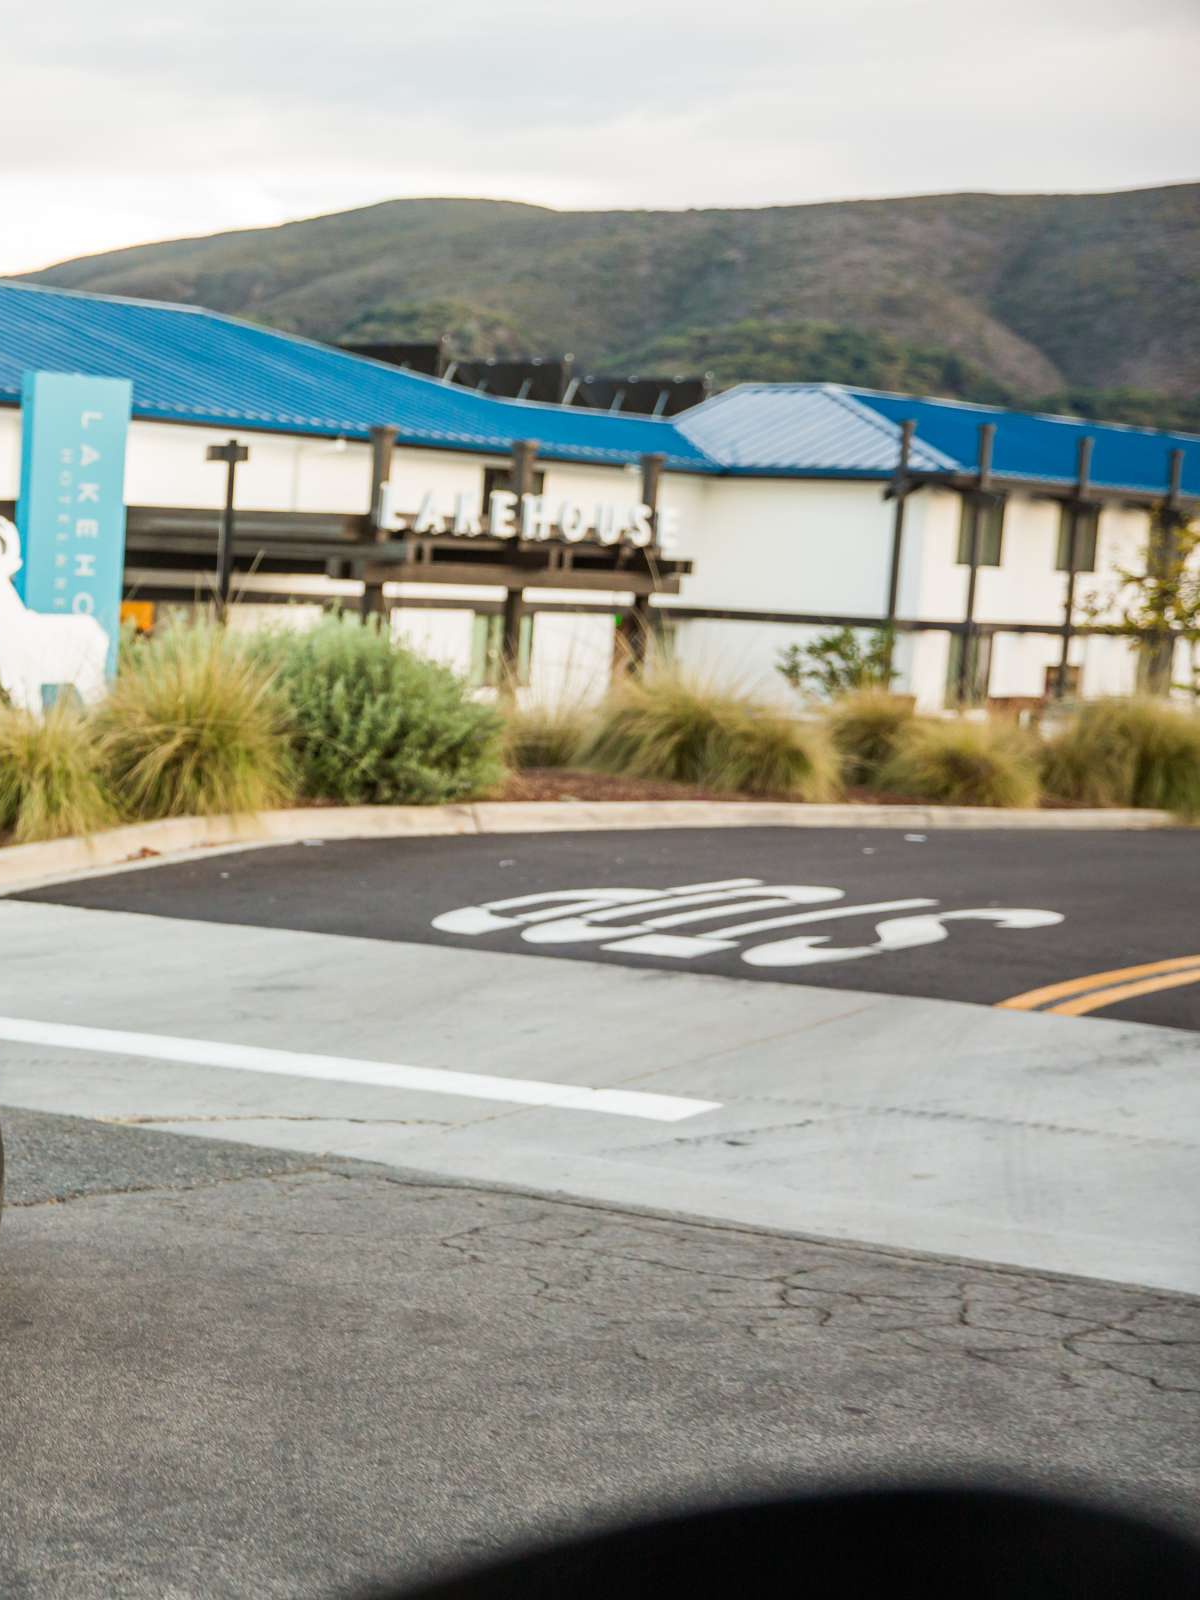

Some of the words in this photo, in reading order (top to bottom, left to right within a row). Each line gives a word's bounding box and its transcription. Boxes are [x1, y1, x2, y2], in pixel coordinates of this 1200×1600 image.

[71, 410, 103, 615] LAKEHO
[378, 481, 682, 548] LAKEHOUSE
[431, 877, 1065, 968] STOP
